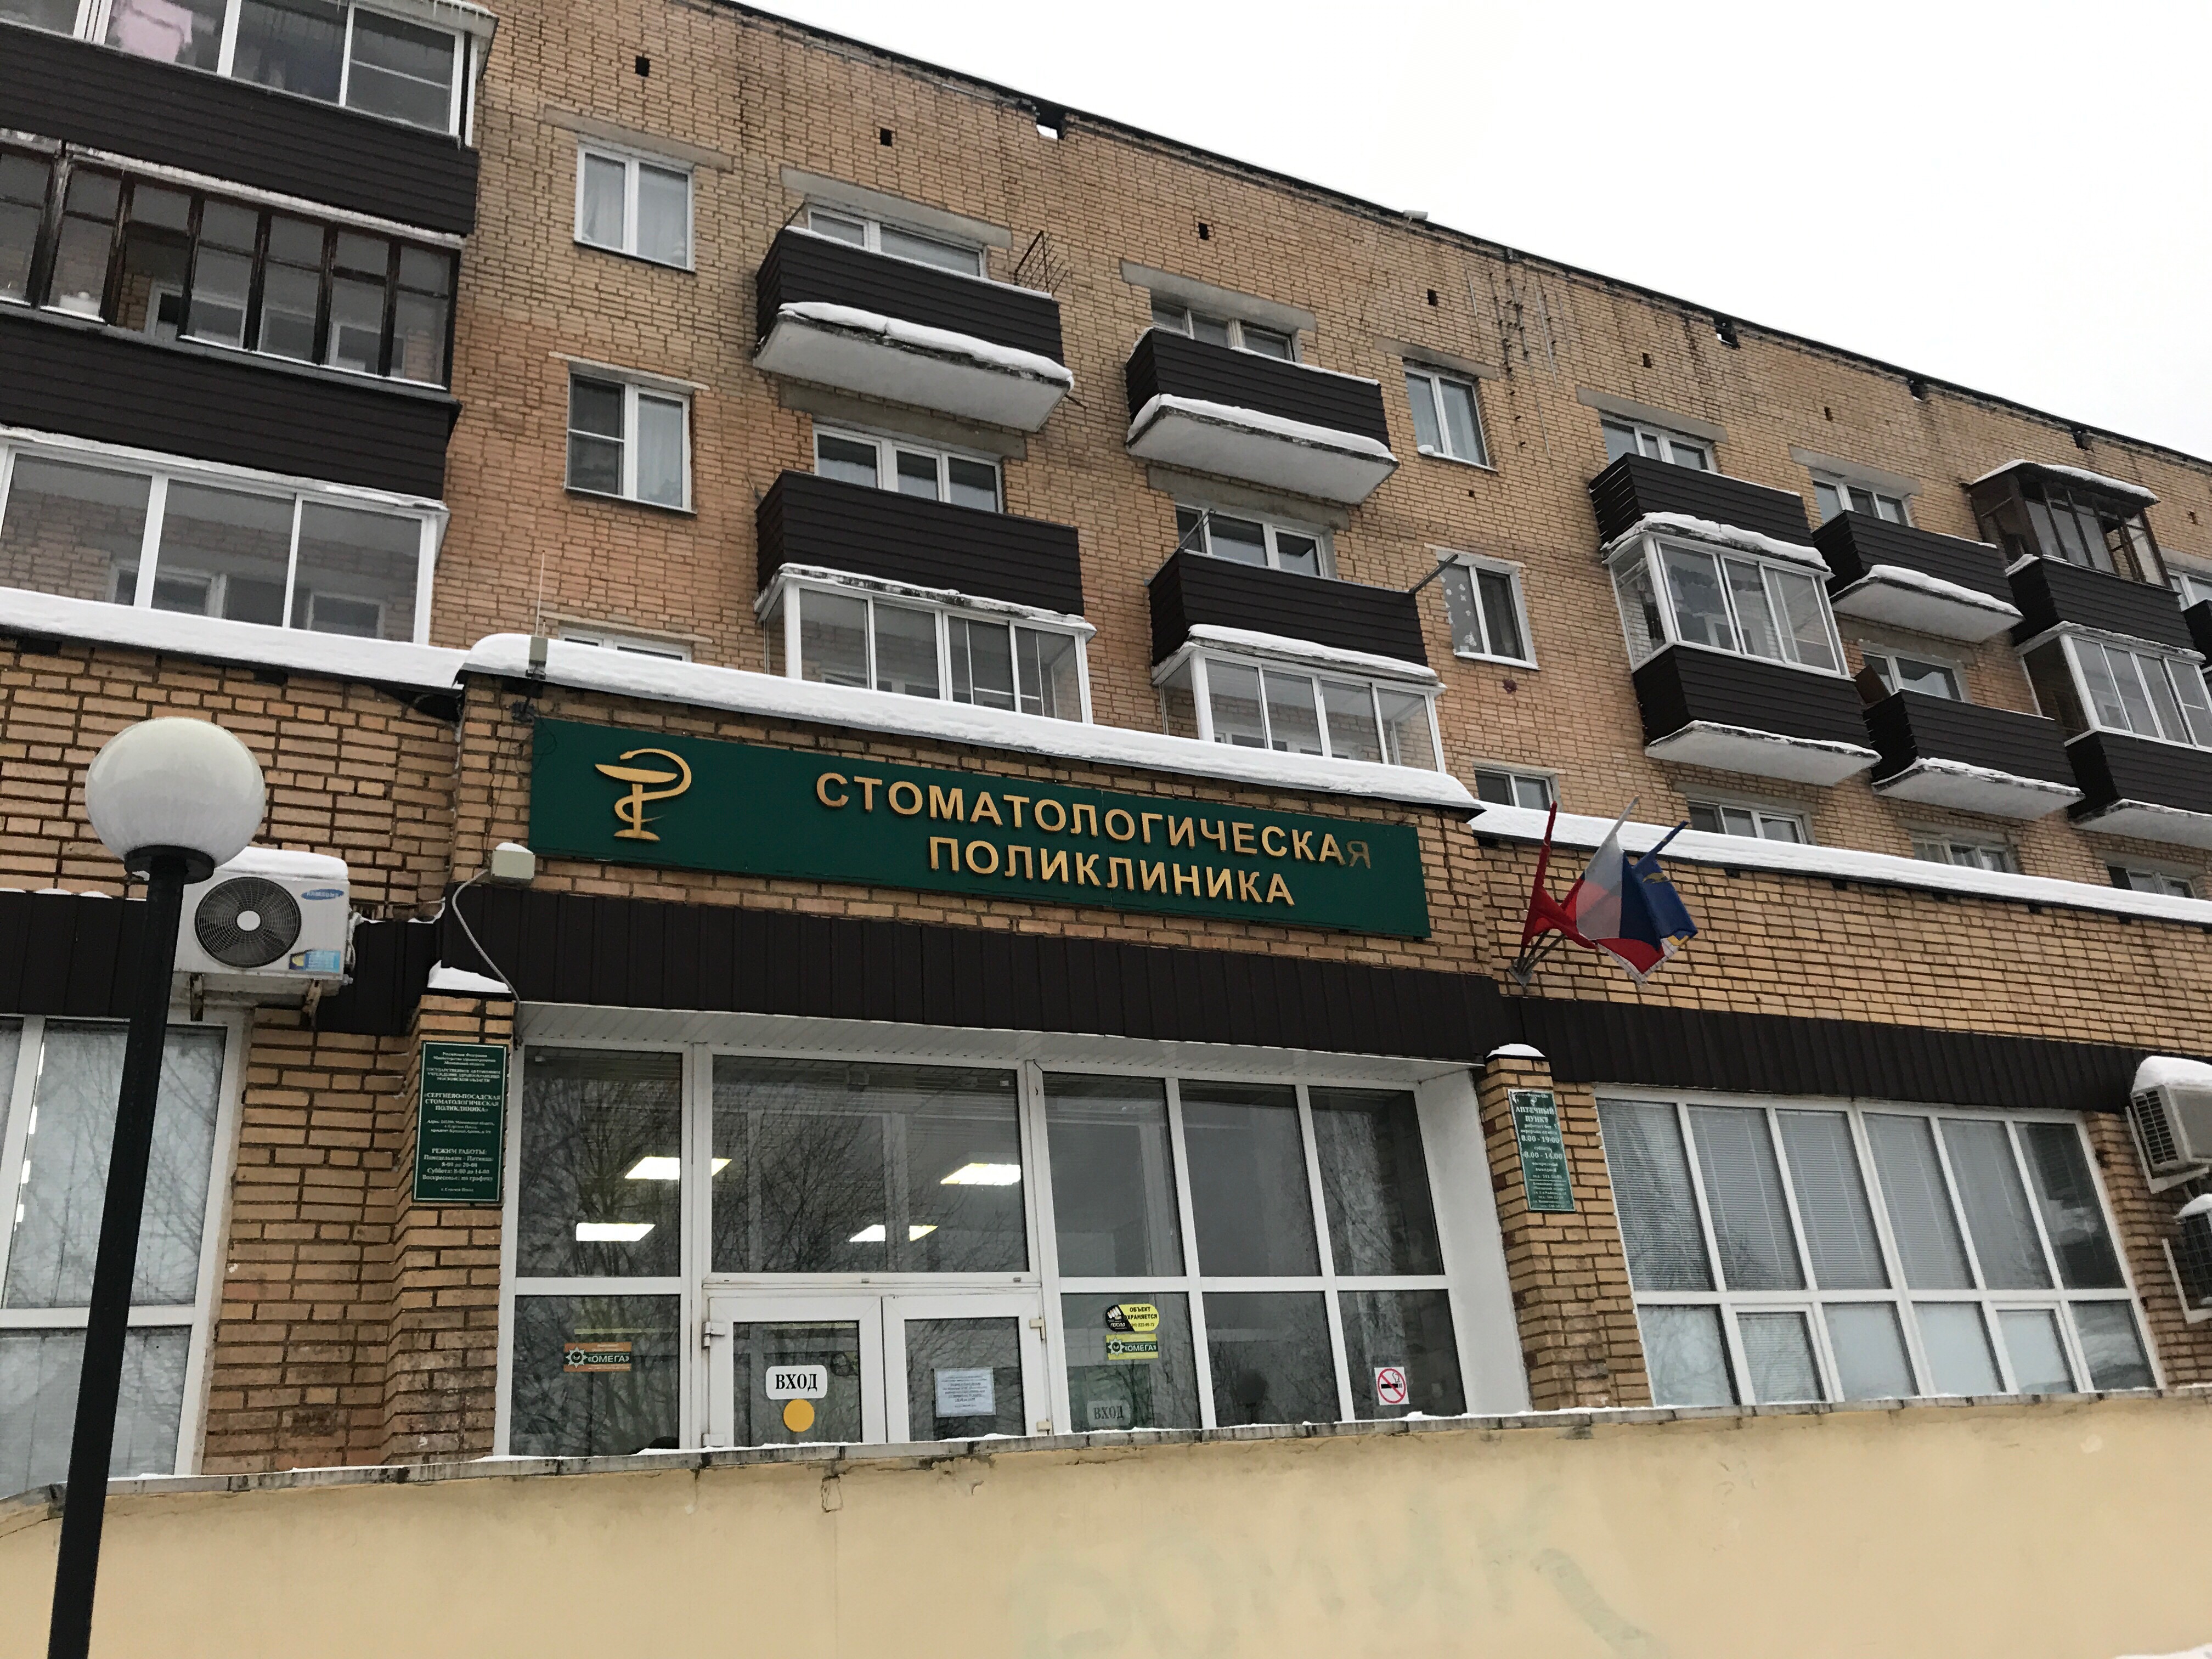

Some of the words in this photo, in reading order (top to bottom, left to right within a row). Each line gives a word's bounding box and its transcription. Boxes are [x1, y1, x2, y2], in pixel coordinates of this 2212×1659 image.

[816, 772, 1372, 870] СТОМАТОЛОГИЧЕСКАЯ
[929, 836, 1295, 907] ПОЛИКЛИНИКА
[1516, 1106, 1555, 1115] АПТЕЧНЫЙ
[588, 1355, 630, 1363] «ОМЕГА»
[775, 1373, 817, 1392] ВХОД
[1093, 1405, 1124, 1421] ВХОД
